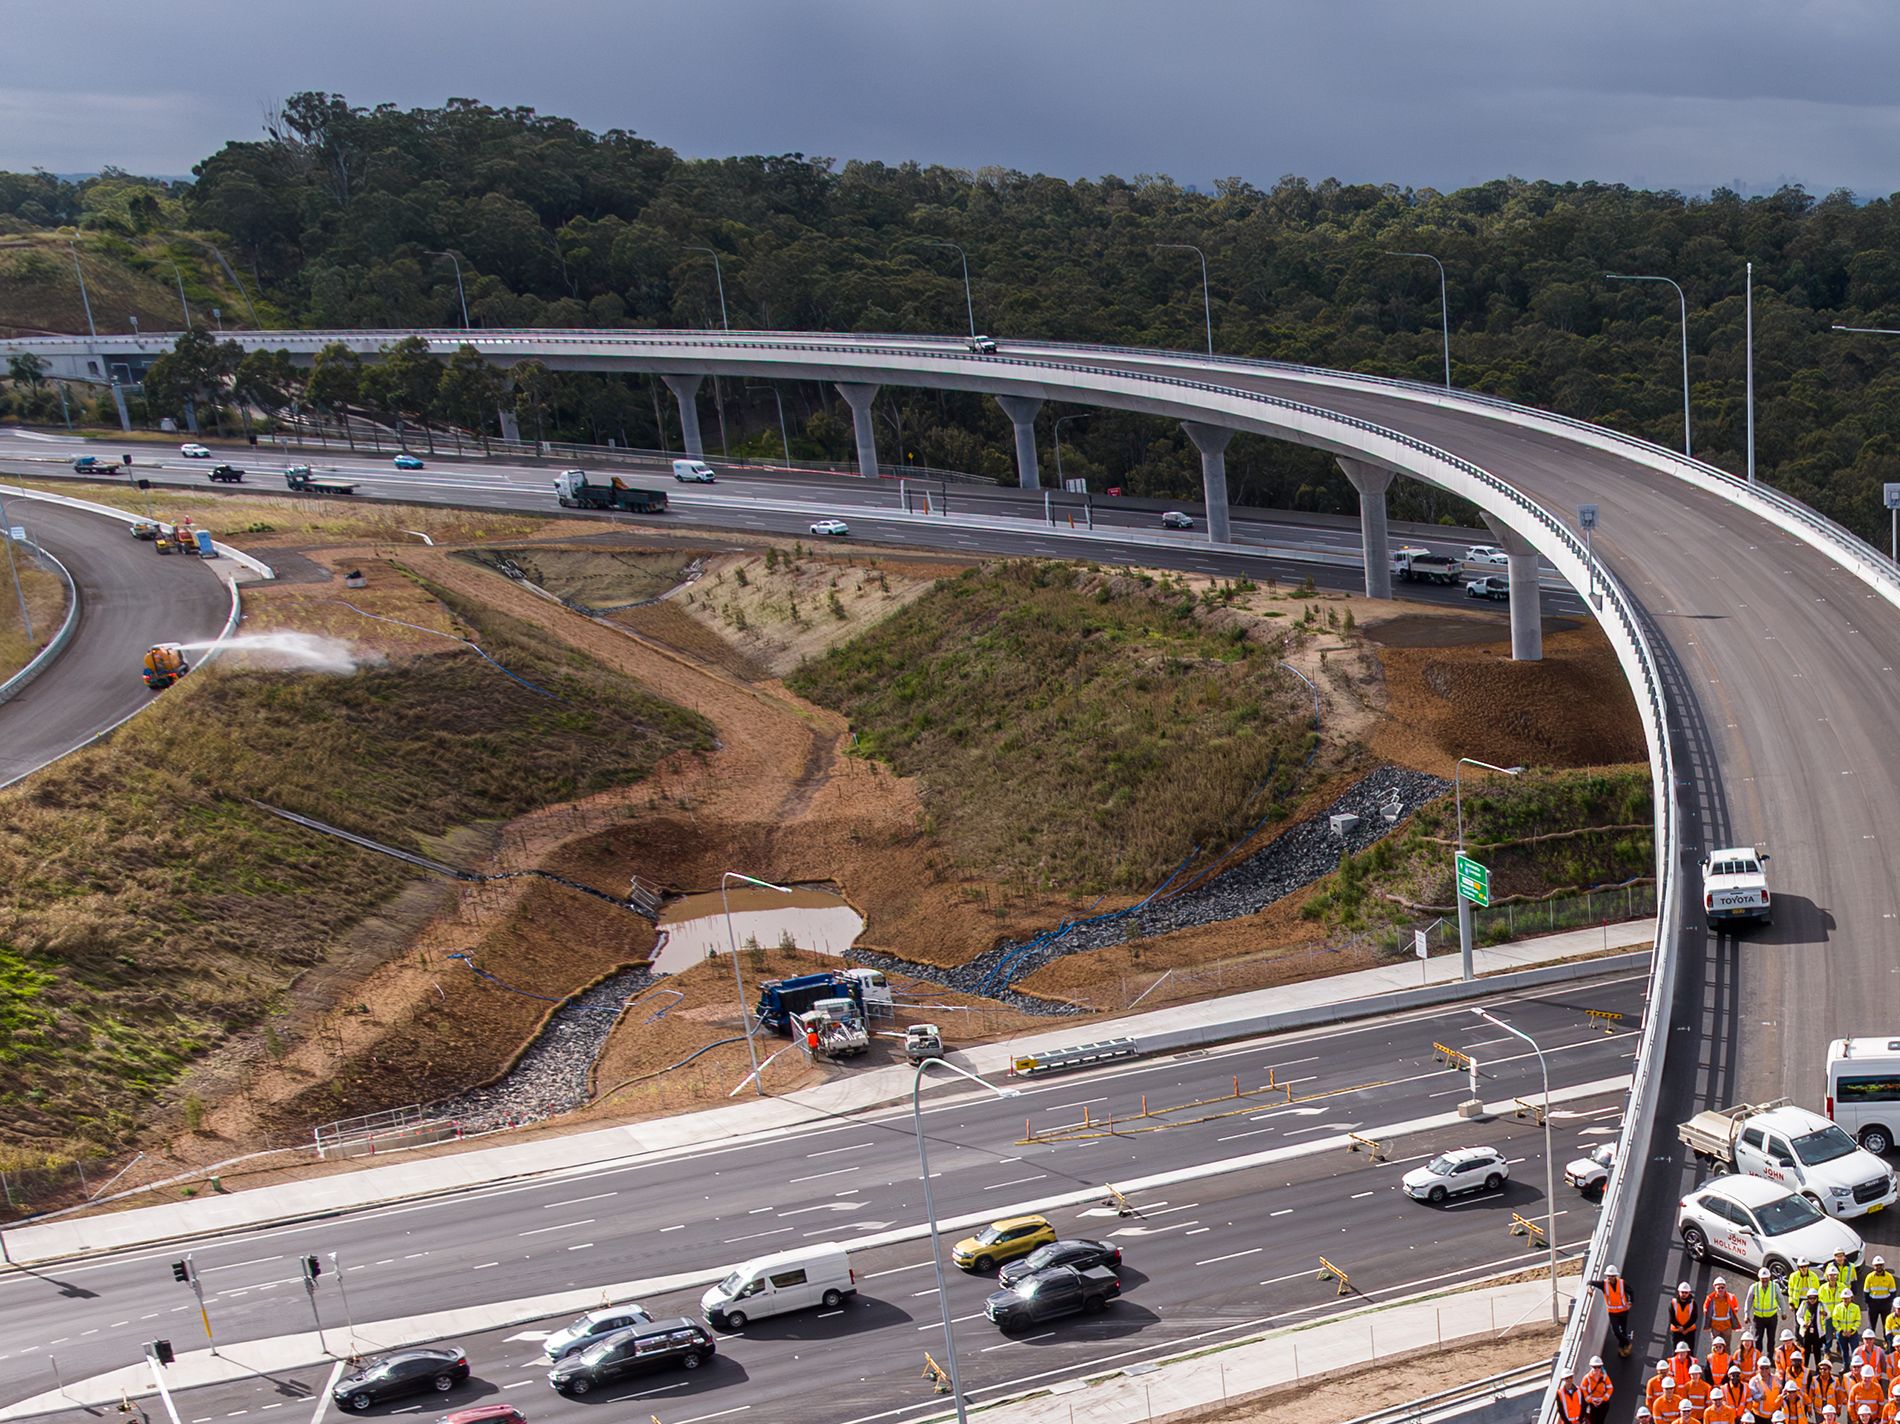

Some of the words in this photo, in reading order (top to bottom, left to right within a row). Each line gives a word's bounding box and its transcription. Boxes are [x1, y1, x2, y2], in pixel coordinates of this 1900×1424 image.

[1720, 896, 1755, 904] TOYOTA
[1763, 1167, 1784, 1180] JOHN
[1728, 1233, 1746, 1246] JOHN
[1714, 1237, 1746, 1256] HOLLAND
